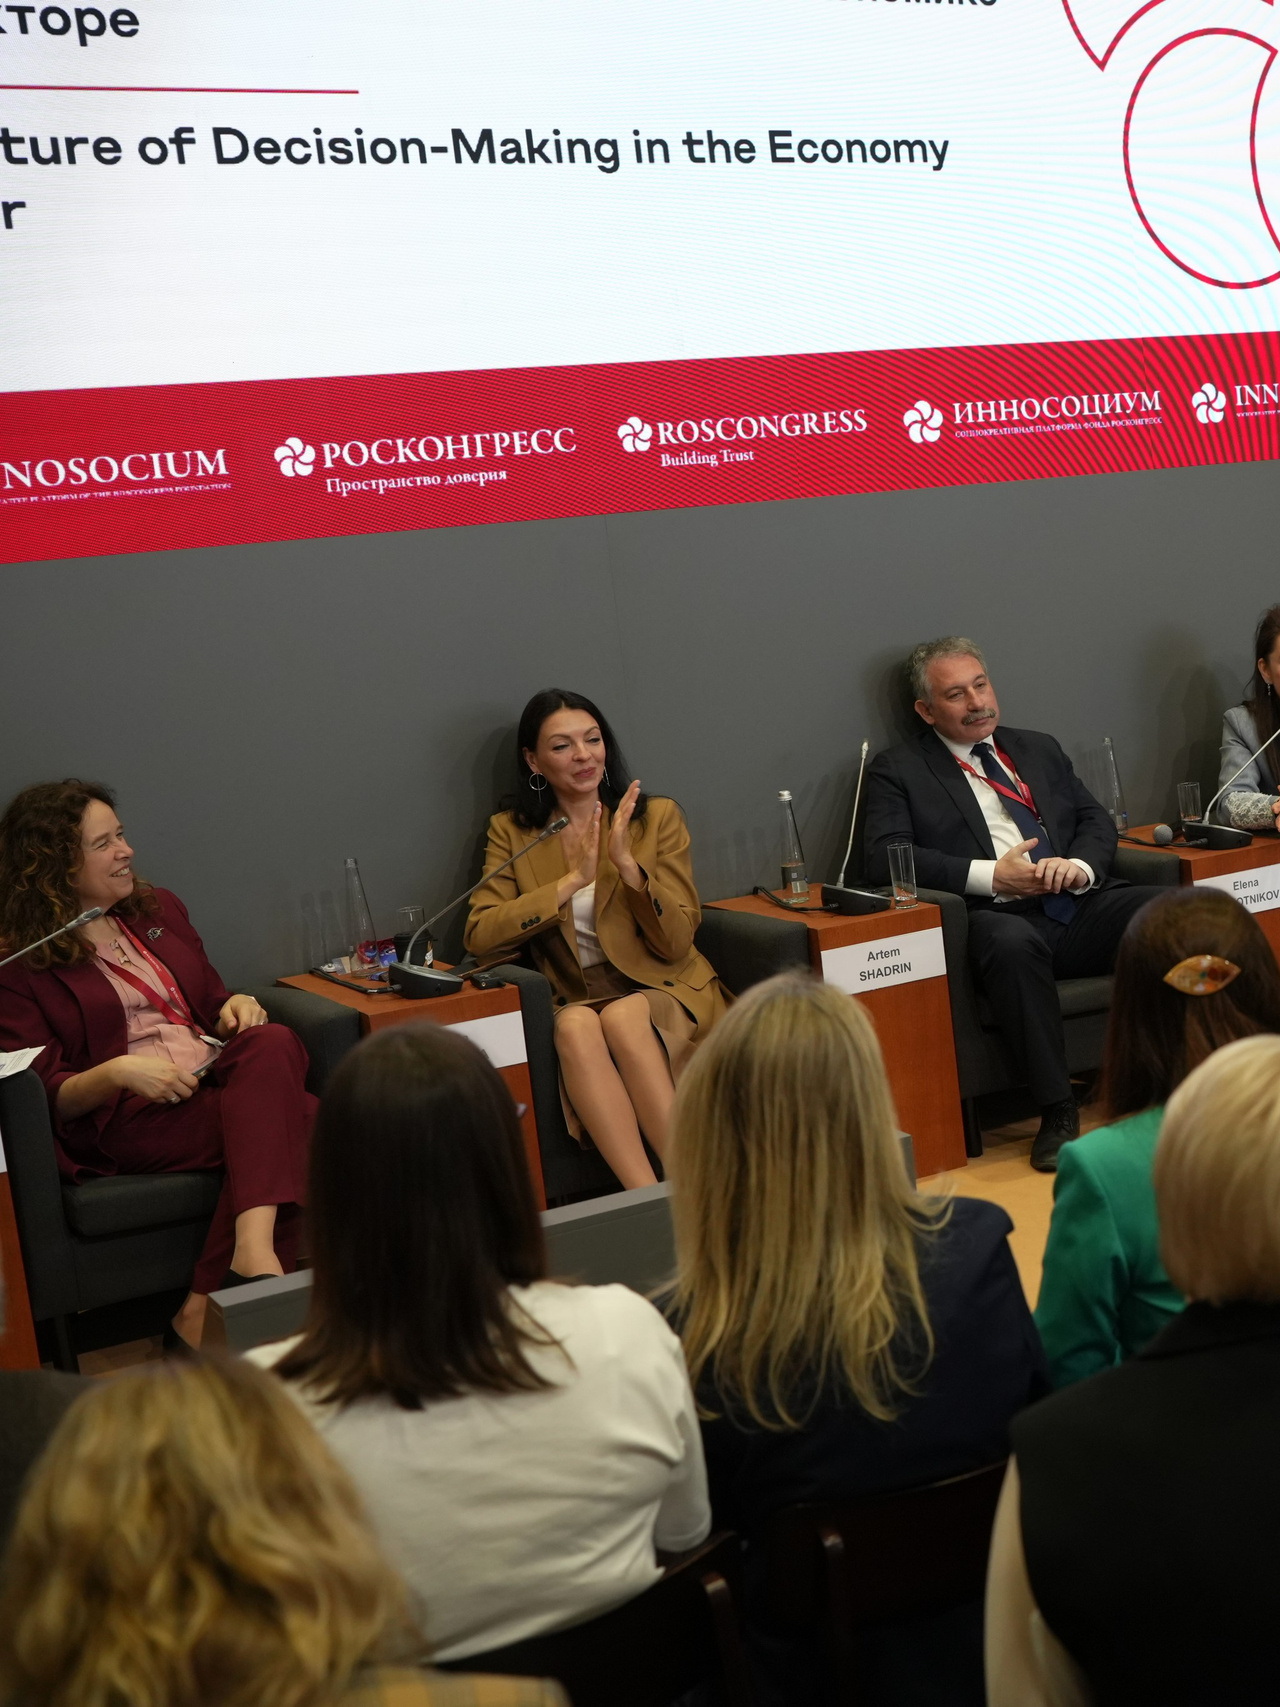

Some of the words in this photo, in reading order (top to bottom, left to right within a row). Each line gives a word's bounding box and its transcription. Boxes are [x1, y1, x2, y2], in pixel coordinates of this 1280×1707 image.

[0, 5, 139, 46] торе
[0, 127, 122, 165] ture
[138, 127, 196, 164] of
[213, 128, 620, 174] Decision-Making
[633, 129, 670, 164] in
[682, 130, 756, 164] the
[768, 130, 949, 171] Economy
[953, 390, 1162, 423] ИННОСОЦИУМ
[657, 409, 868, 445] ROSCONGRESS
[322, 427, 577, 468] РОСКОНГРЕСС
[661, 451, 718, 467] Building
[719, 449, 755, 463] Trust
[0, 449, 230, 489] NOSOCIUM
[326, 474, 441, 496] Пространство
[444, 470, 507, 487] доверия
[1233, 878, 1259, 891] Elena
[867, 948, 900, 962] Artem
[859, 962, 912, 982] SHADRIN
